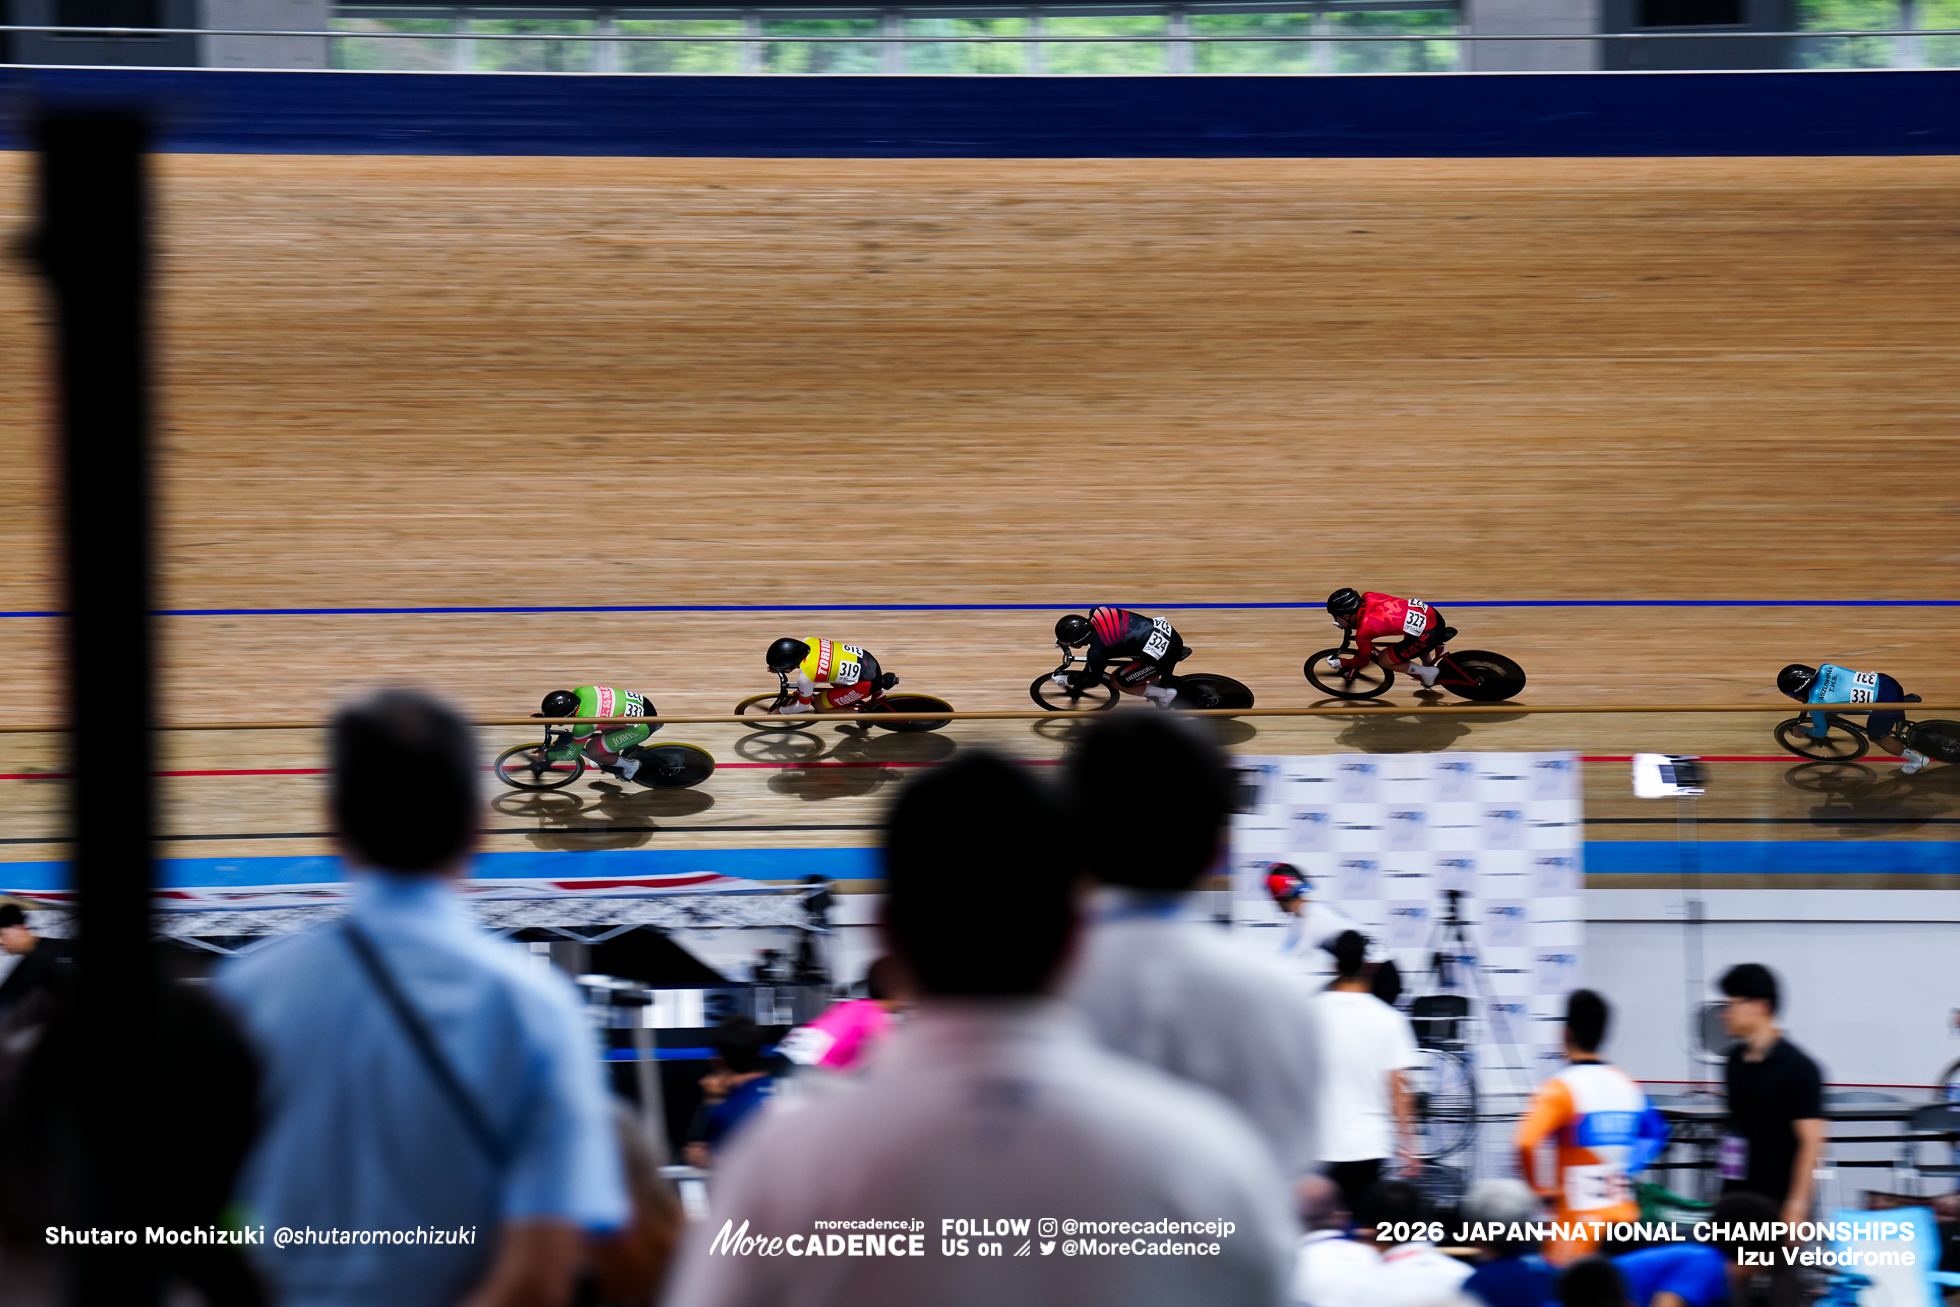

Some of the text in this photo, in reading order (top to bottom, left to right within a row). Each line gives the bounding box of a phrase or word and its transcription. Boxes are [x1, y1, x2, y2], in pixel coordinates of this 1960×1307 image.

[1406, 611, 1426, 628] 327
[1148, 633, 1168, 652] 324
[840, 662, 860, 678] 319
[1851, 688, 1871, 703] 331
[625, 703, 643, 717] 333
